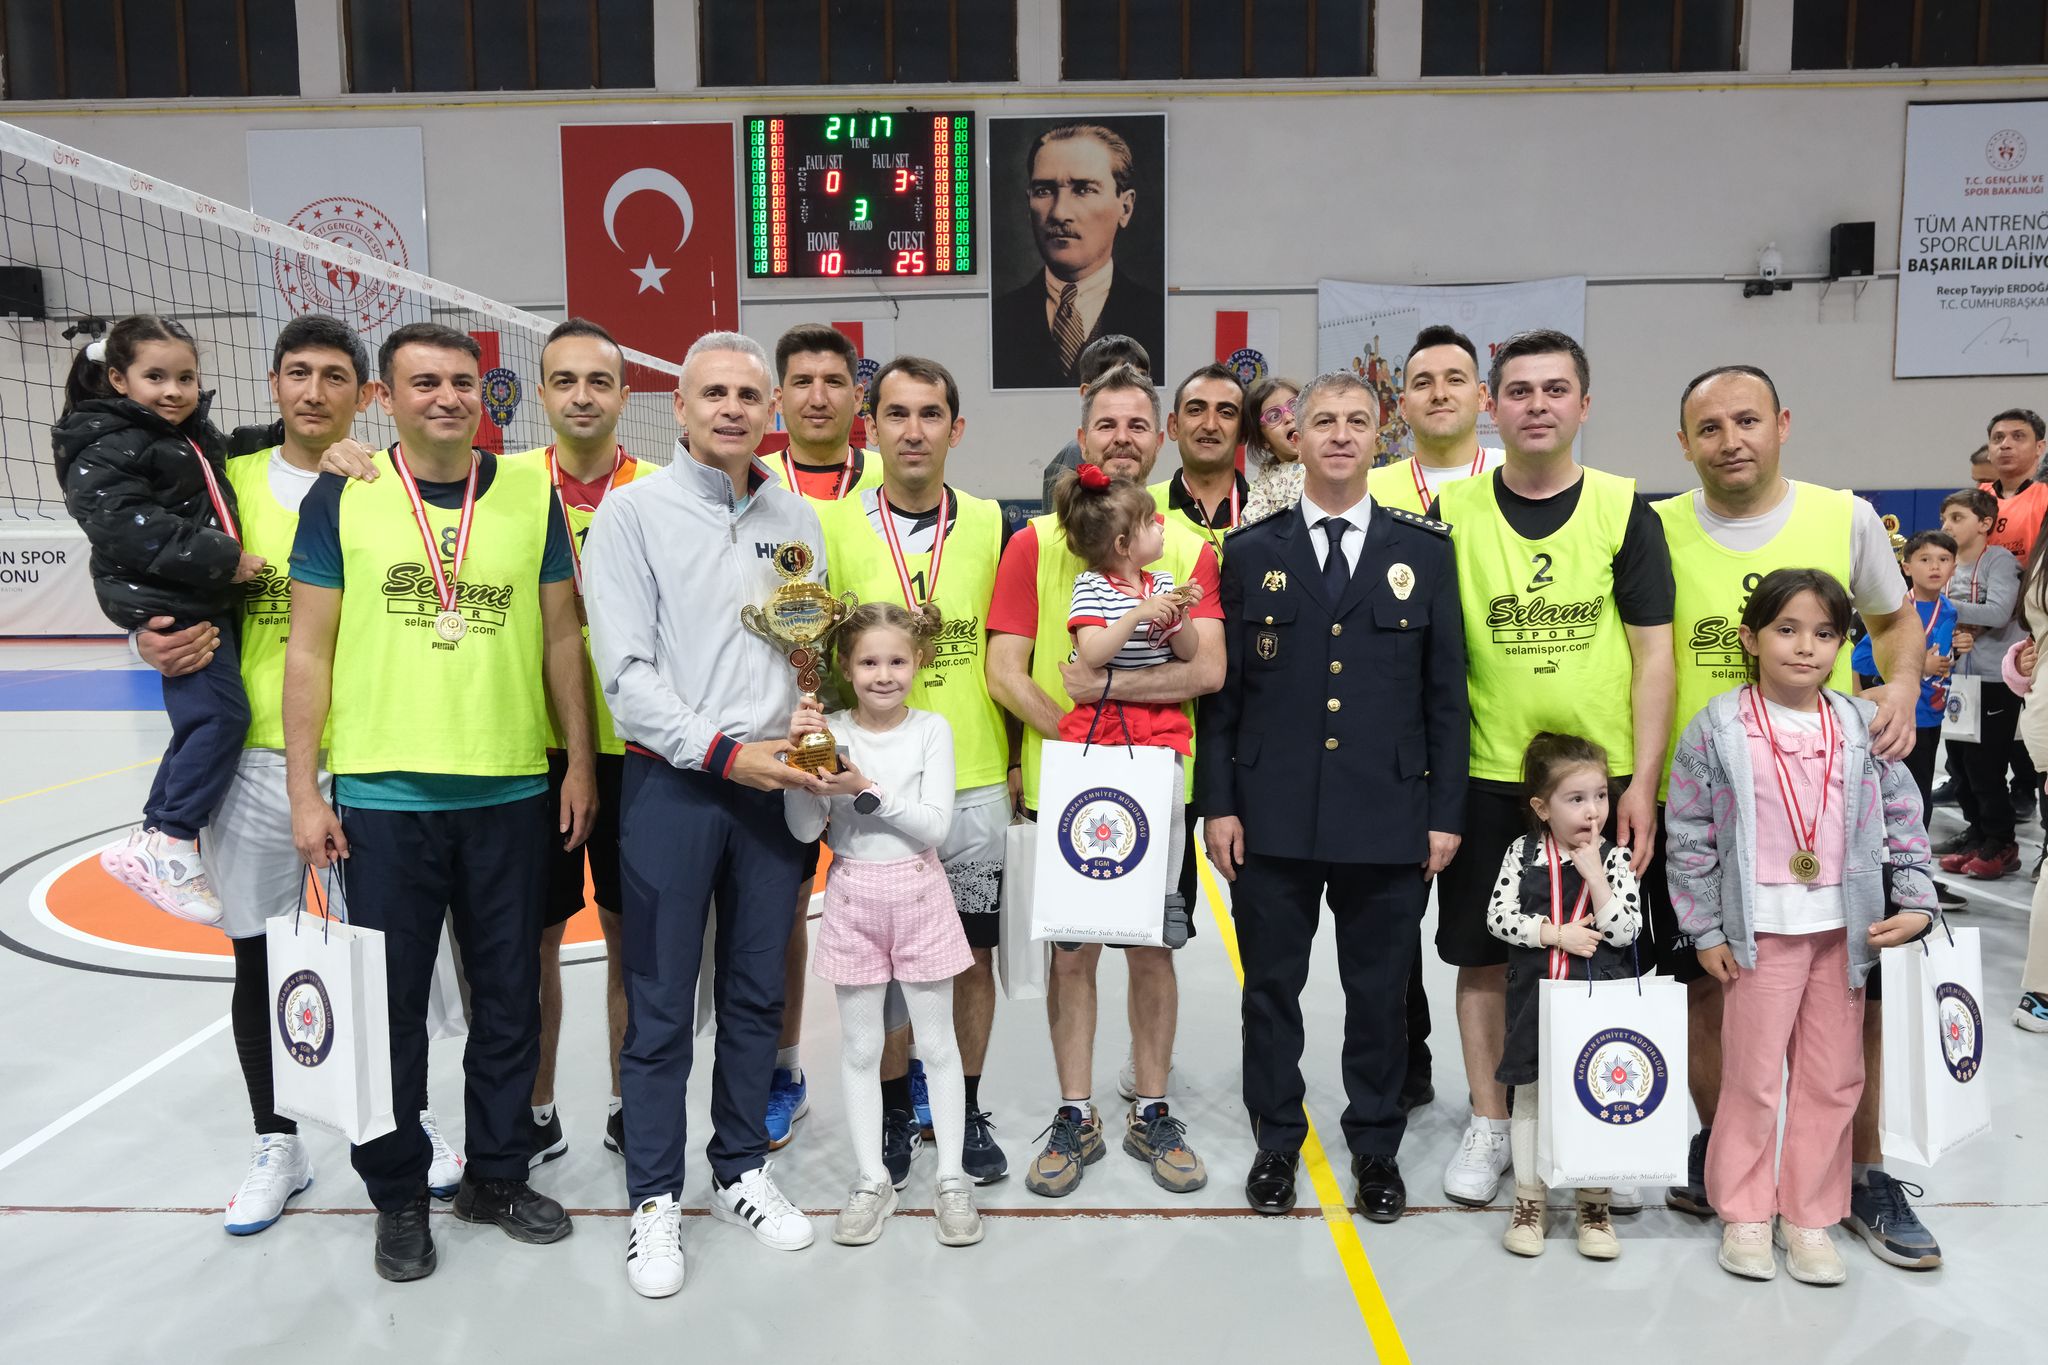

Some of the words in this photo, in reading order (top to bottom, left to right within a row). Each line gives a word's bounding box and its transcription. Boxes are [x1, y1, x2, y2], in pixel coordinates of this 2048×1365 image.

[850, 137, 870, 149] TIME
[64, 154, 80, 168] TVF
[806, 154, 843, 170] FAUL/SET
[872, 153, 909, 169] FAUL/SET
[140, 180, 153, 192] TVF
[826, 171, 840, 192] 0
[894, 170, 908, 192] 3
[1986, 174, 2028, 186] GENÇLİK
[2032, 175, 2044, 184] VE
[1964, 187, 1990, 196] SPOR
[1992, 184, 2044, 196] BAKANLIĞI
[203, 203, 216, 215] TVF
[854, 199, 867, 221] 3
[327, 222, 364, 236] GENÇLİK
[364, 232, 372, 243] VE
[849, 220, 873, 231] PERIOD
[1914, 213, 1956, 234] TÜM
[807, 231, 840, 252] HOME
[888, 230, 925, 251] GUEST
[820, 253, 841, 274] 10
[896, 251, 925, 273] 25
[1907, 256, 1997, 275] BAŞARILAR
[1937, 286, 1968, 298] Recep
[1970, 284, 2004, 297] Tayyip
[1960, 296, 2048, 310] CUMHURBAŞKA
[1996, 517, 2007, 533] 8
[440, 526, 458, 558] 8
[21, 551, 67, 565] SPOR
[1531, 552, 1554, 584] 2
[911, 571, 926, 600] 1
[418, 602, 481, 619] SPR
[1486, 594, 1604, 628] Selami
[1516, 629, 1576, 641] SPOR
[1505, 641, 1590, 656] selamispor.com
[1062, 798, 1084, 833] KARAMAN
[1083, 790, 1118, 801] EMNİYET
[1118, 795, 1147, 838] MÜDÜRLÜĞÜ
[1578, 1043, 1597, 1080] KARAMAN
[1596, 1031, 1629, 1045] EMNİYET
[1630, 1035, 1665, 1078] MÜDÜRLÜĞÜ
